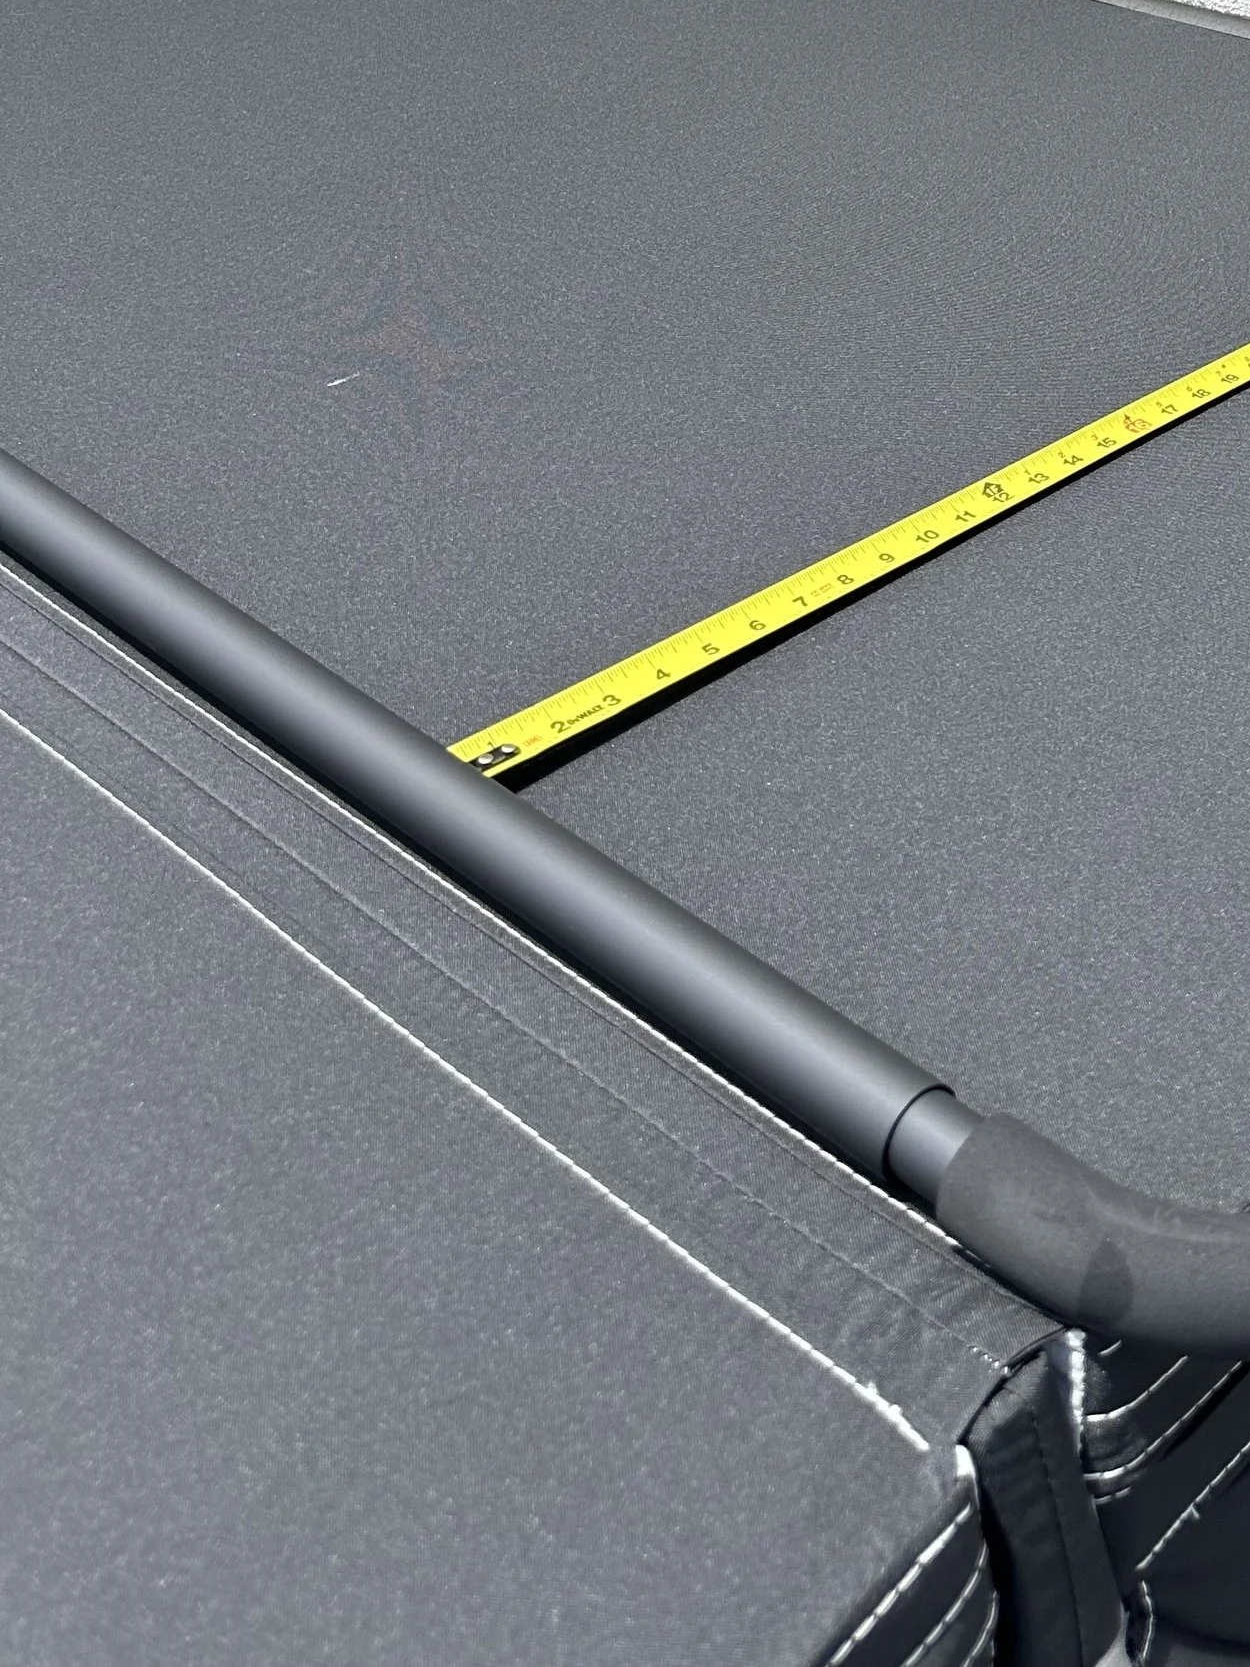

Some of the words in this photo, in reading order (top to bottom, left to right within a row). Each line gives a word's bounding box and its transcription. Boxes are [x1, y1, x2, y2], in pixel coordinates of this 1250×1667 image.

[551, 721, 571, 733] 2
[603, 694, 621, 706] 3
[656, 669, 671, 680] 4
[702, 643, 720, 655] 5
[749, 620, 766, 631] 6
[792, 596, 808, 607] 7
[837, 574, 855, 585] 8
[879, 553, 895, 563] 9
[915, 530, 939, 544] 10
[955, 510, 976, 524] 11
[992, 492, 1015, 502] 12
[1028, 473, 1050, 484] 13
[1063, 454, 1084, 466] 14
[1096, 437, 1117, 449] 15
[1161, 404, 1178, 415] 17
[1191, 389, 1211, 399] 18
[1220, 374, 1239, 383] 19
